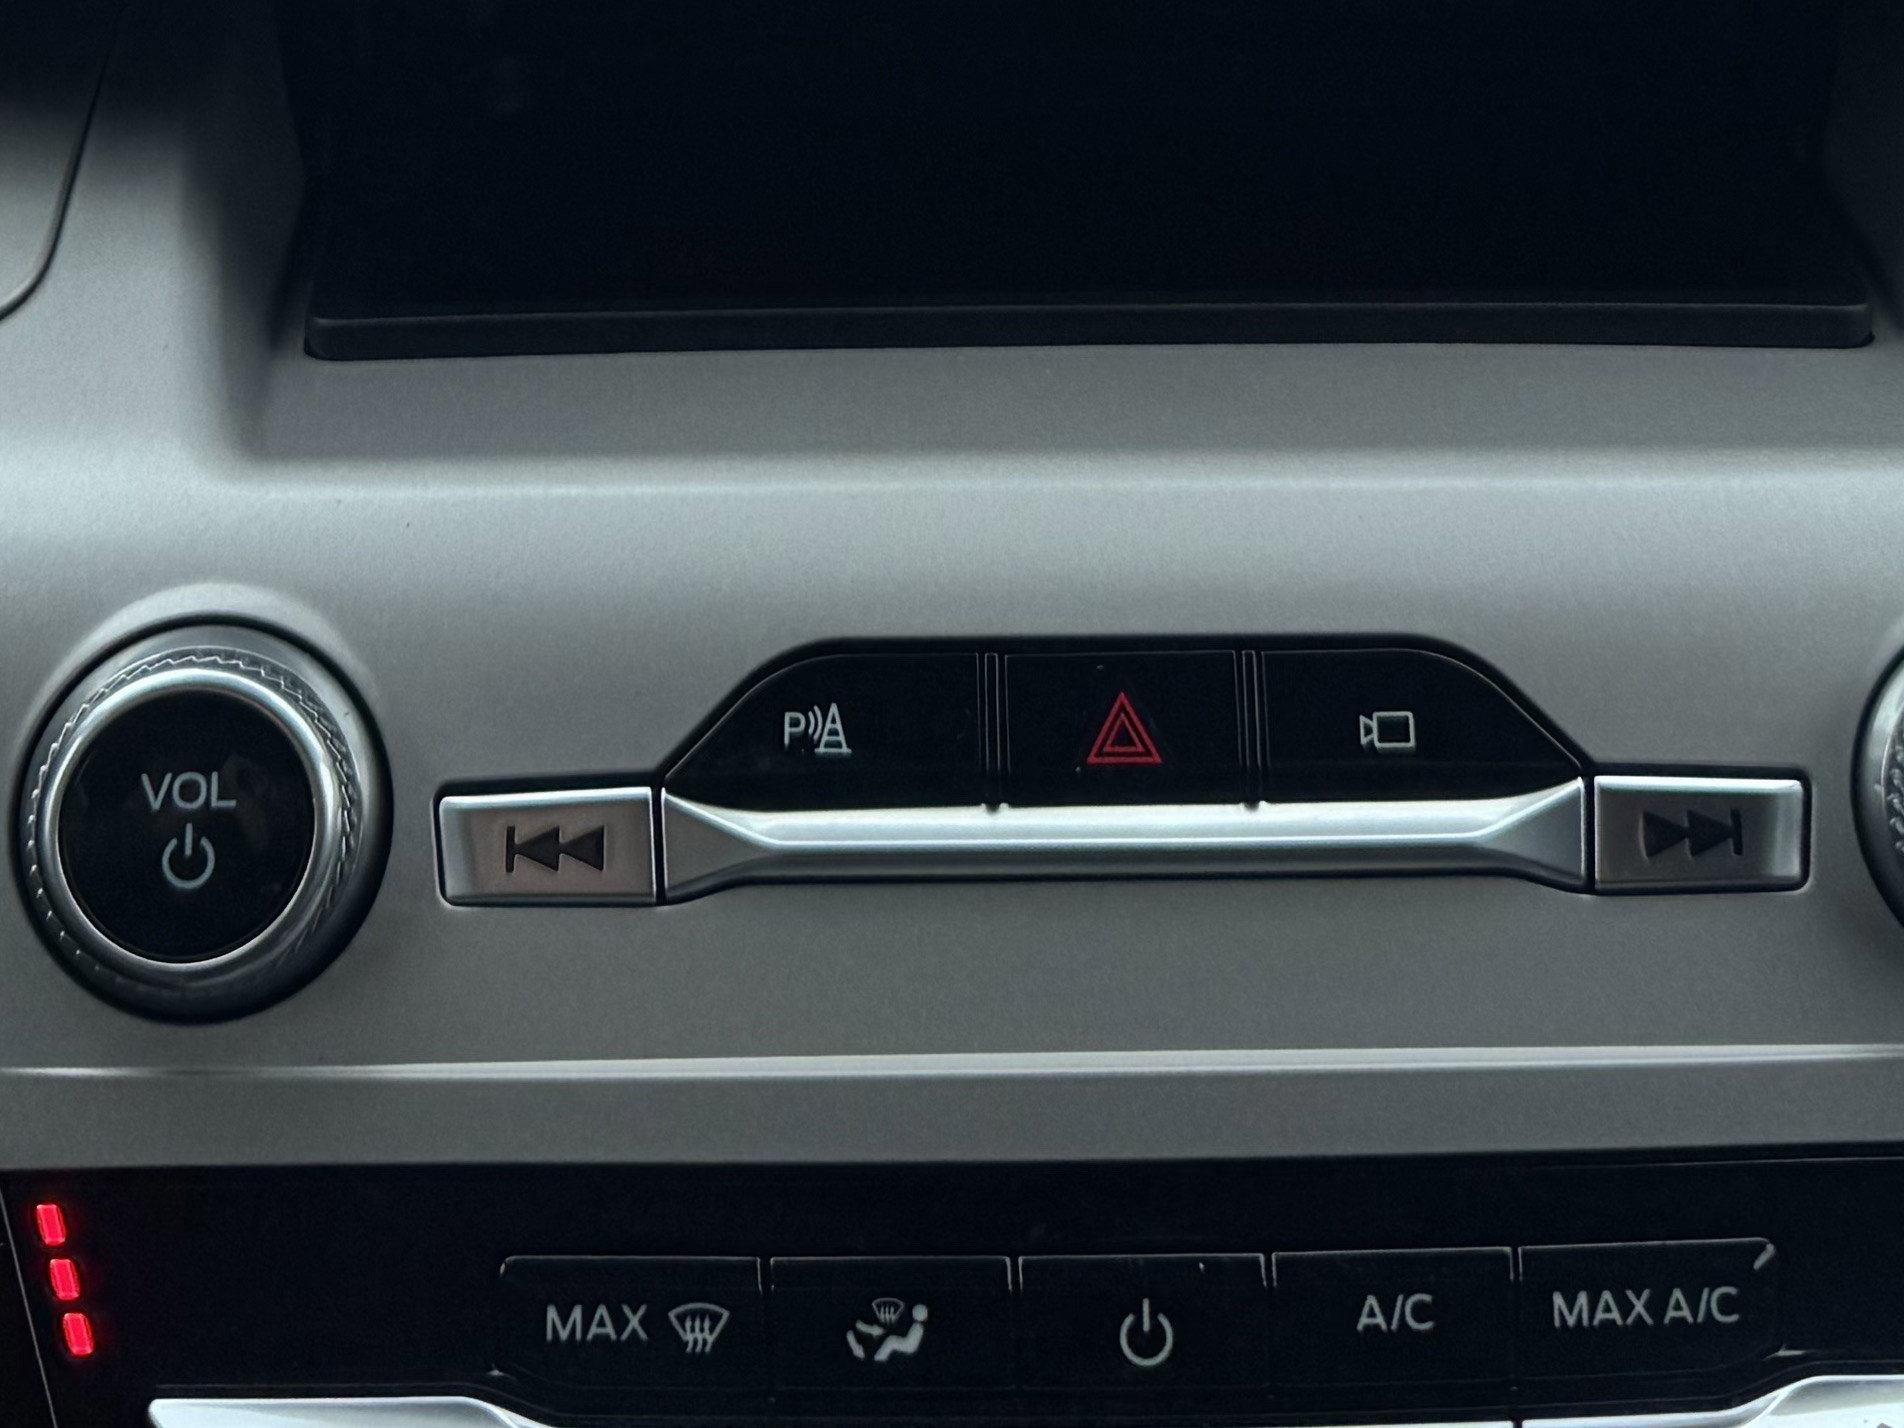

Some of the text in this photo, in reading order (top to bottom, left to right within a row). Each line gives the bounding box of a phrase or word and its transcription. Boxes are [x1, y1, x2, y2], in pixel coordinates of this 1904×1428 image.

[140, 772, 237, 810] VOL
[544, 1304, 649, 1342] MAX
[1356, 1292, 1436, 1334] A/C
[1552, 1285, 1740, 1330] MAX A/C
